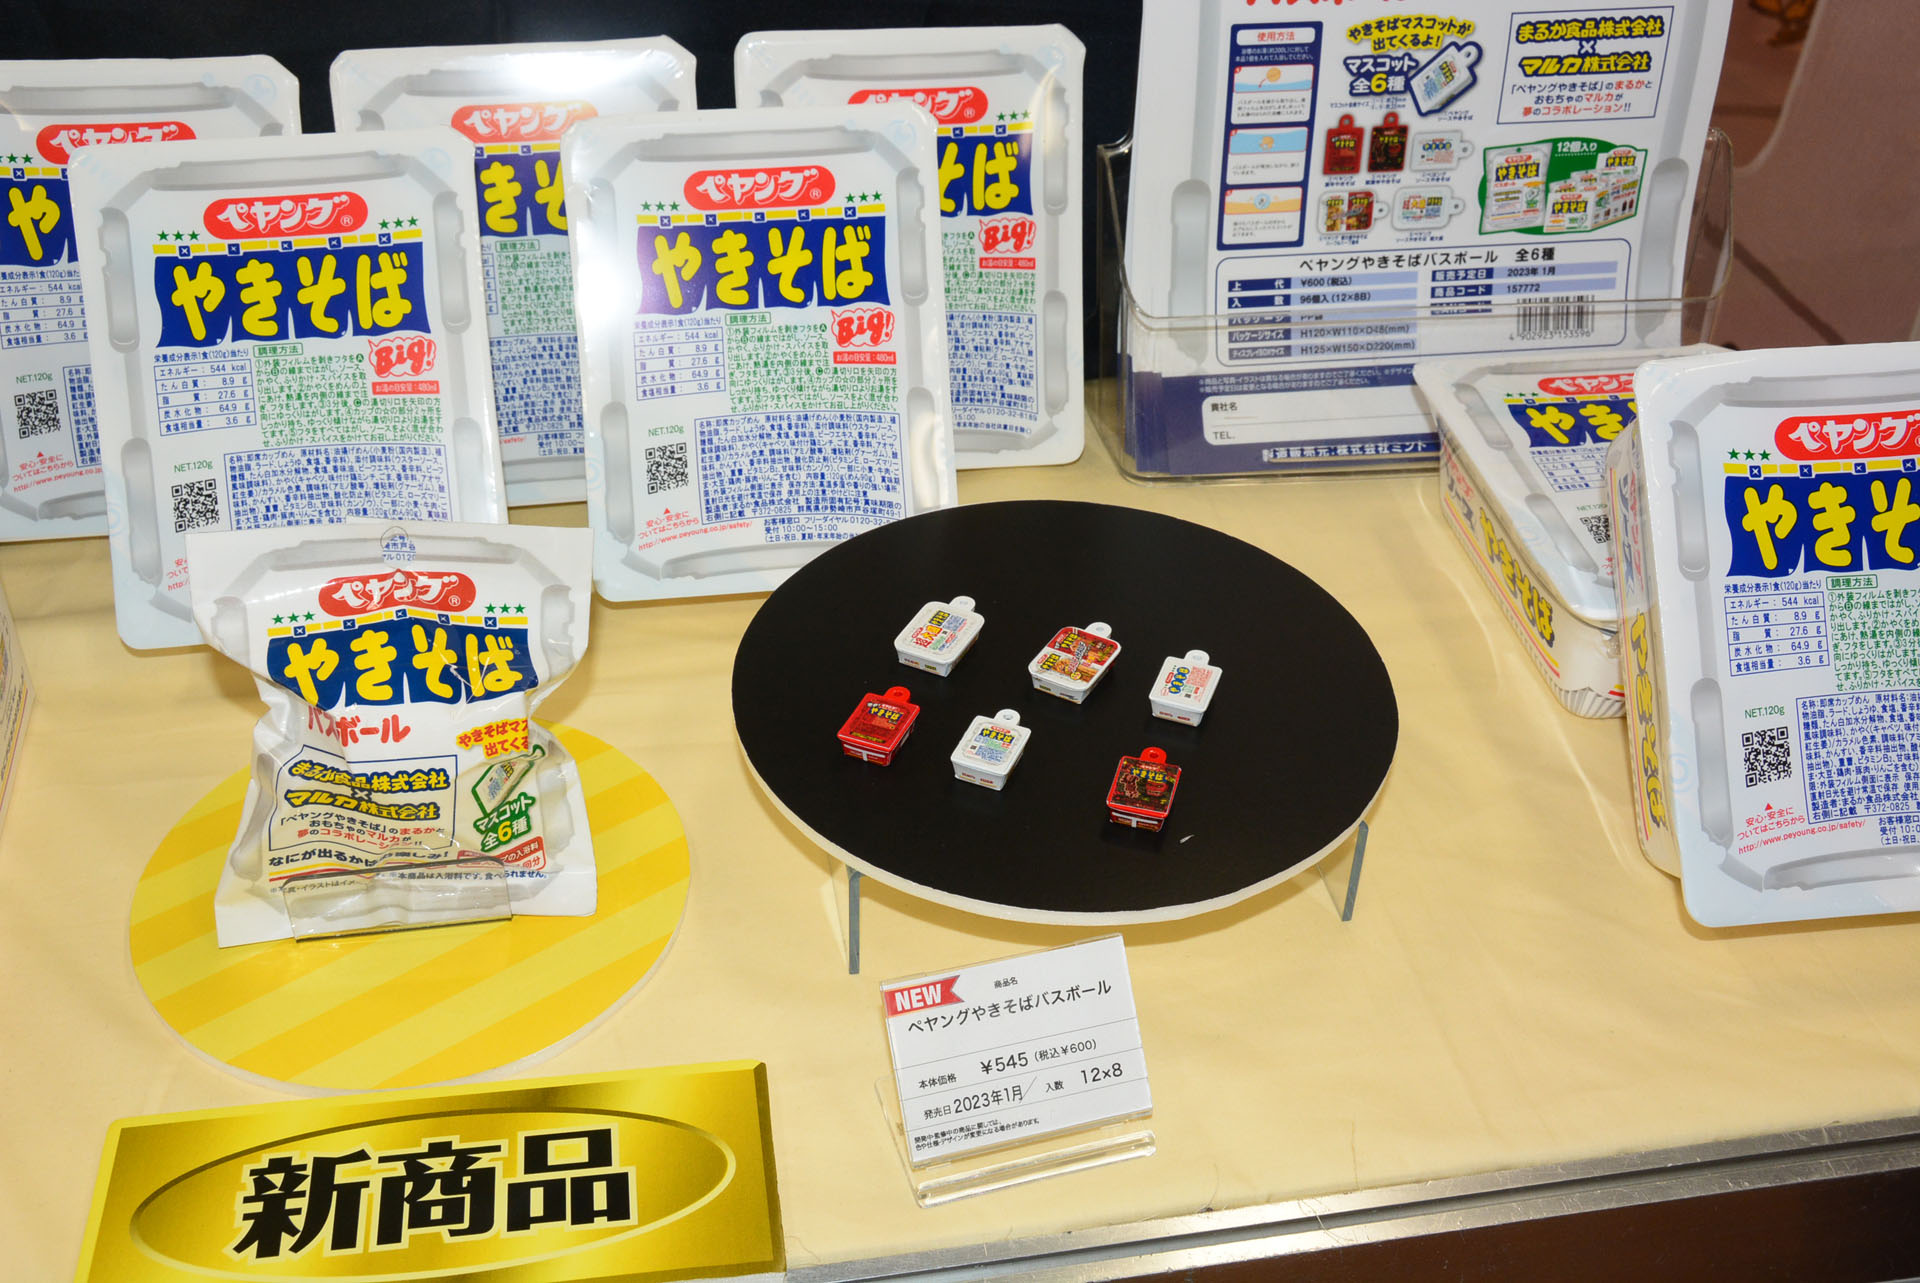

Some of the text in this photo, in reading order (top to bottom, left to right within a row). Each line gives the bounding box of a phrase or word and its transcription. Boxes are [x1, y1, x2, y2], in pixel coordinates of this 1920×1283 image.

[1348, 17, 1472, 40] やきそばマスコットが
[1518, 17, 1664, 42] まるか食品株式会社
[1257, 31, 1295, 42] 使用方法
[1346, 55, 1416, 74] マスコット
[1520, 55, 1650, 75] マルカ株式会社
[1352, 73, 1405, 93] 全6種
[1534, 93, 1623, 105] おもちゃのマルカが
[1557, 141, 1597, 153] 12個入り
[696, 168, 819, 205] ペヤング
[217, 194, 350, 233] ペヤング
[983, 220, 1034, 252] Big!
[1300, 247, 1555, 272] ペヤングやきそばバスボール 全6種
[652, 225, 873, 309] やきそば
[1435, 269, 1487, 281] 販売予定日
[171, 251, 412, 341] やきそば
[1434, 284, 1540, 297] 商品コード 157772
[729, 314, 767, 324] 調理方法
[836, 310, 892, 345] Big!
[685, 331, 700, 341] 544
[258, 346, 299, 355] 調理方法
[695, 344, 707, 353] 8.9
[375, 339, 432, 375] Big!
[691, 356, 708, 366] 27.6
[210, 363, 247, 373] 544 kcal
[691, 370, 708, 379] 64.9
[222, 377, 235, 386] 8.9
[697, 382, 710, 391] 3.6
[218, 391, 236, 399] 27.6
[219, 403, 237, 412] 64.9
[1211, 402, 1238, 412] 貴社名
[225, 416, 239, 425] 3.6
[1526, 402, 1637, 444] やき
[648, 425, 685, 437] NET.120g
[1212, 431, 1236, 440] TEL.
[1788, 413, 1920, 455] ペヤング
[174, 460, 213, 473] NET.120g
[639, 517, 699, 539] ついてはこちらから
[1724, 580, 1822, 594] 栄養成分表示1食(120g)当たり
[1831, 576, 1873, 588] 調理方法
[332, 572, 459, 610] ペヤング
[1781, 595, 1819, 607] 544 kcal
[1794, 611, 1807, 621] 8.9
[1790, 626, 1808, 636] 27.6
[1791, 641, 1810, 651] 64.9
[284, 624, 523, 704] やきそば
[1797, 655, 1810, 665] 3.6
[1744, 705, 1785, 718] NET.120g
[308, 706, 411, 747] バスボール
[290, 761, 449, 792] まるか食品株式会社
[287, 791, 439, 820] マルカ株式会社
[477, 796, 532, 830] マスコット
[309, 820, 412, 842] おもちゃのマルカが
[484, 816, 528, 848] 全6種
[1737, 815, 1805, 840] ついてはこちらから
[1880, 826, 1897, 836] 受付
[1738, 819, 1866, 855] http://www.peyoung.co.jp/safety/
[994, 977, 1018, 990] 商品名
[894, 984, 942, 1011] NEW
[908, 980, 1111, 1033] ペヤングやきそばバスボール
[919, 1074, 957, 1089] 本体価格
[924, 1105, 951, 1120] 発売日
[953, 1085, 1023, 1114] 2023年1月
[1046, 1081, 1064, 1093] 入数
[232, 1128, 632, 1260] 新商品
